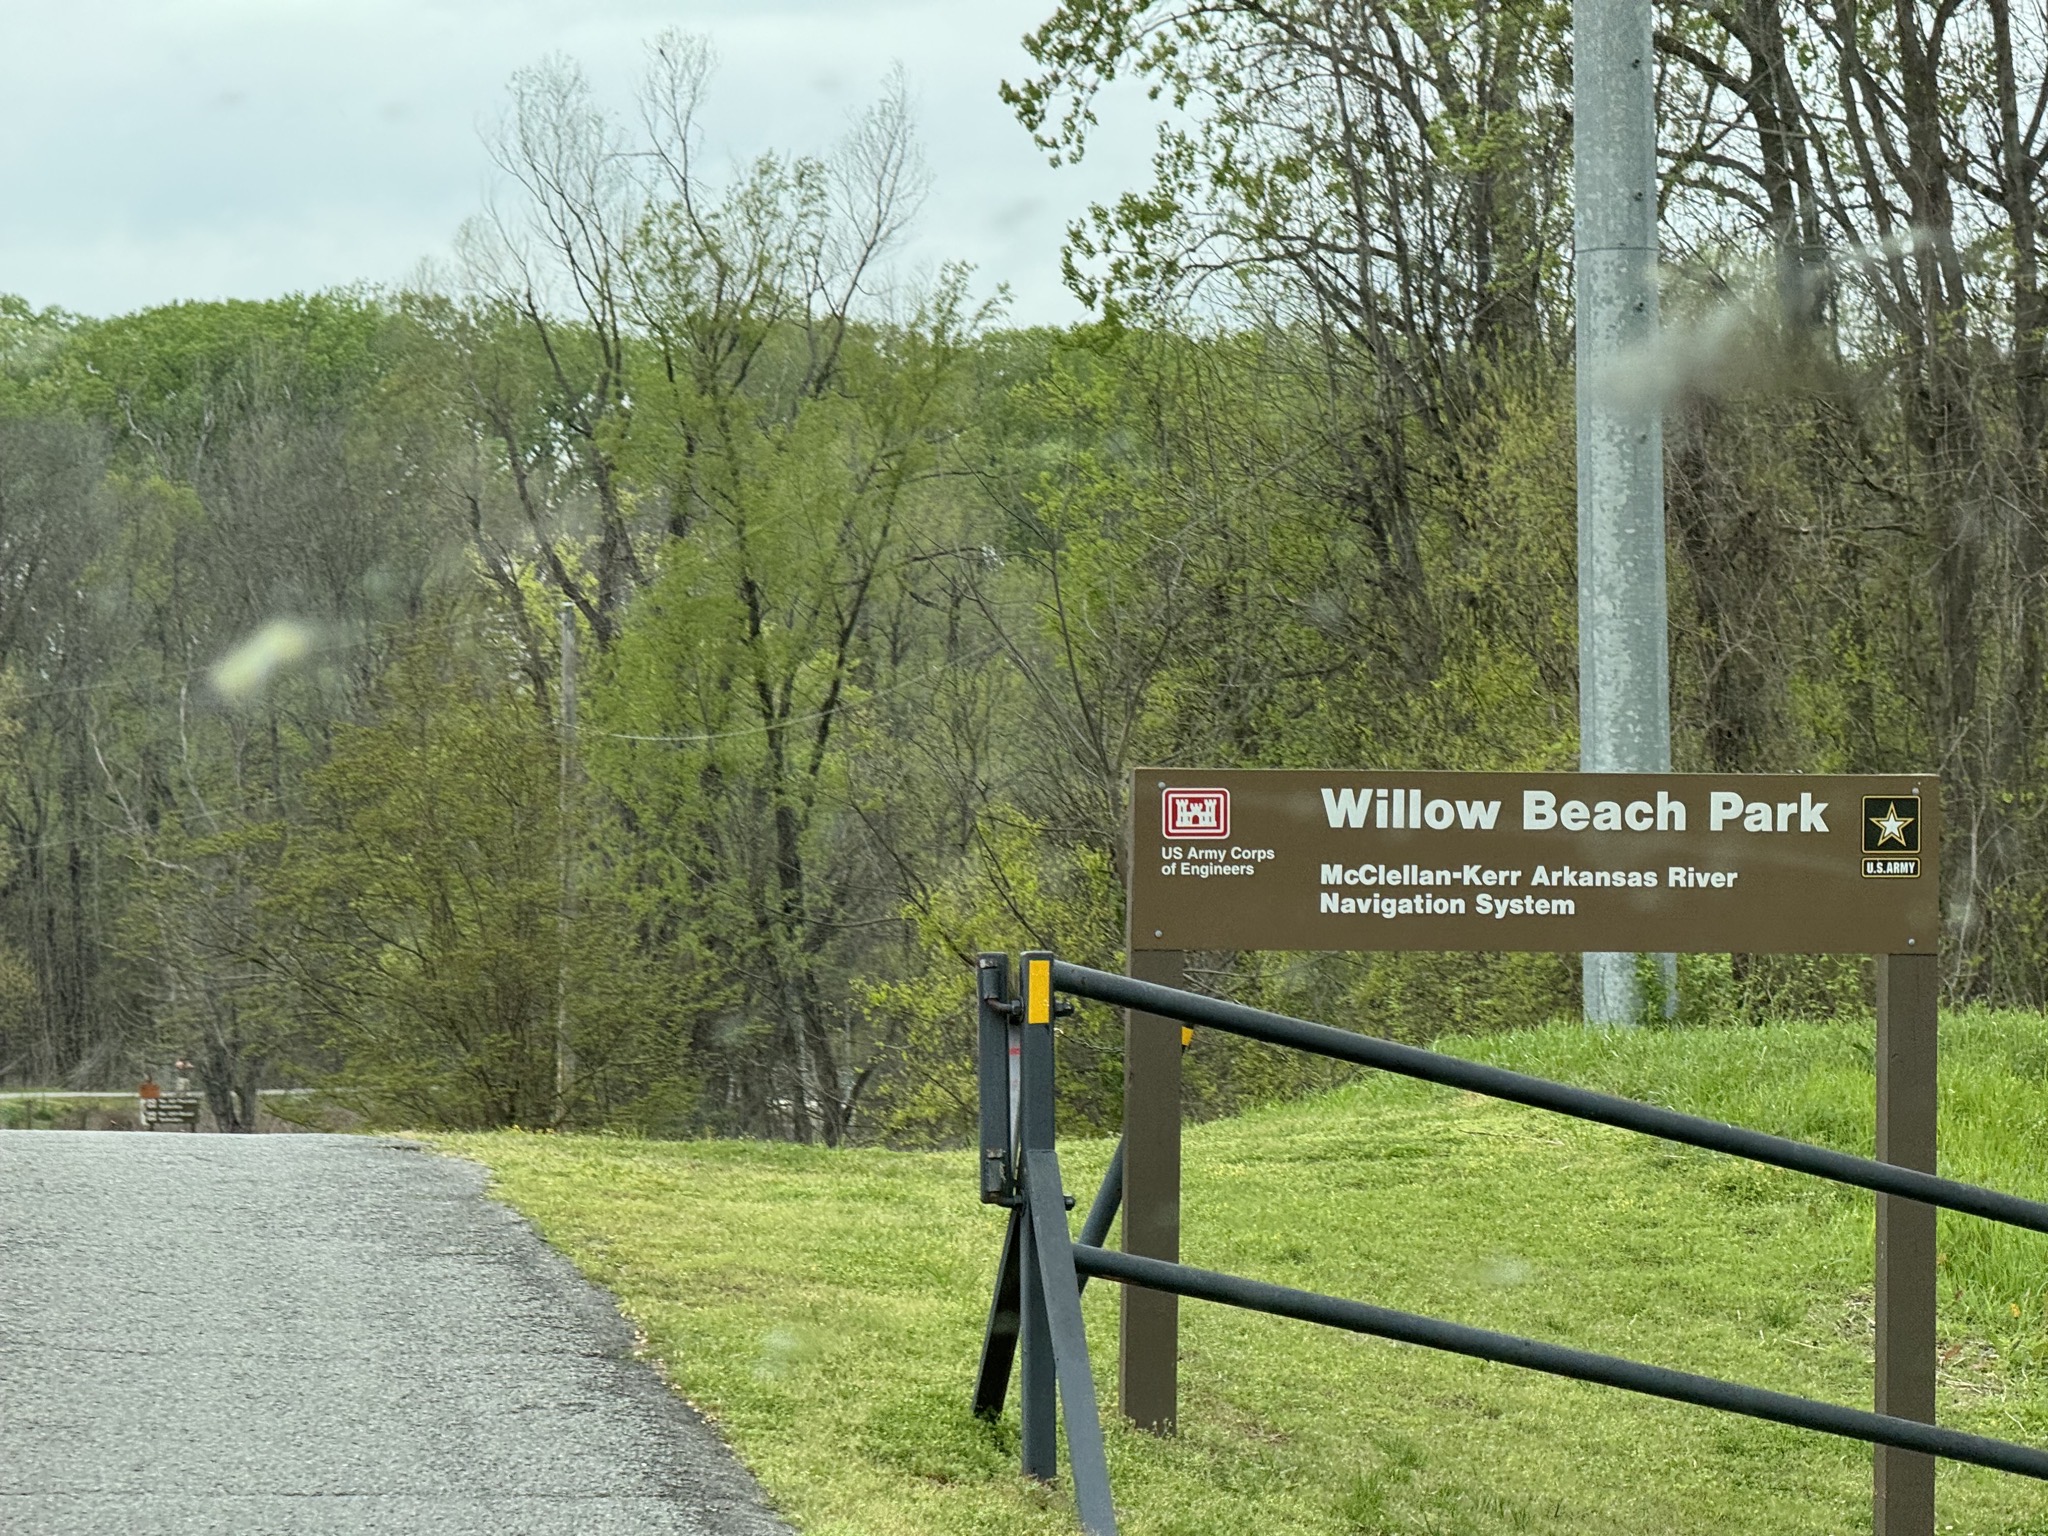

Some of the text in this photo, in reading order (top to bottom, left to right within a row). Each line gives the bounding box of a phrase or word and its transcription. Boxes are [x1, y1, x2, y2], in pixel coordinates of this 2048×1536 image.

[1320, 787, 1830, 833] Willow Beach Park
[1161, 846, 1275, 862] US Army Corps
[1161, 862, 1255, 879] of Engineers
[1320, 863, 1738, 888] McClellan-Kerr Arkansas River
[1320, 892, 1575, 919] Navigation System
